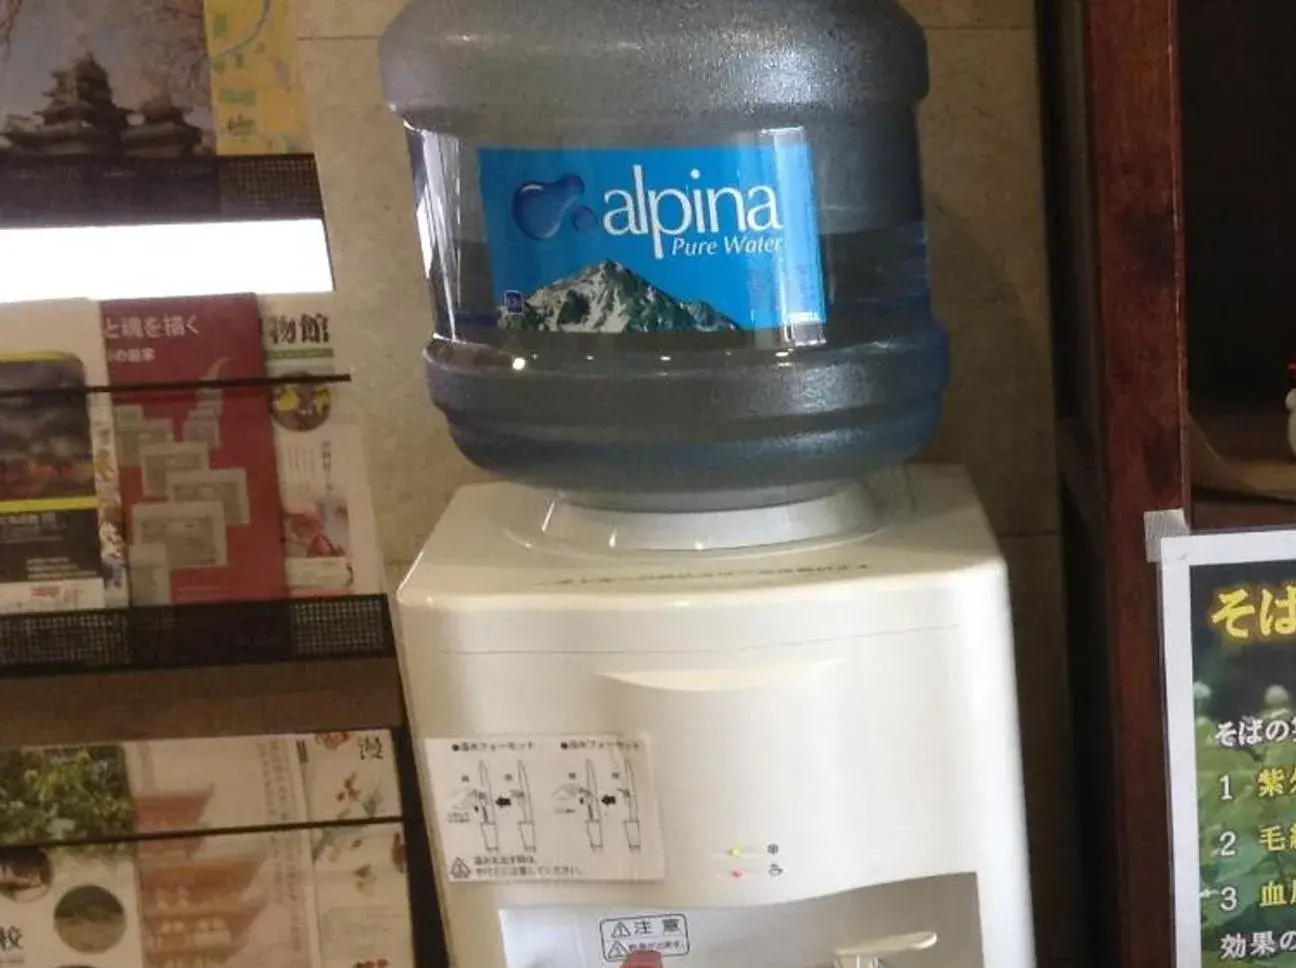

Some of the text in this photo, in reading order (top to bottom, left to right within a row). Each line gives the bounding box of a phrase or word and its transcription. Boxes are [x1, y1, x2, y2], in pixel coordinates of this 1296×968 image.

[603, 164, 783, 259] alpina
[672, 237, 783, 256] Pure Water
[1219, 774, 1233, 800] 1
[1218, 831, 1237, 858] 2
[1219, 886, 1237, 912] 3
